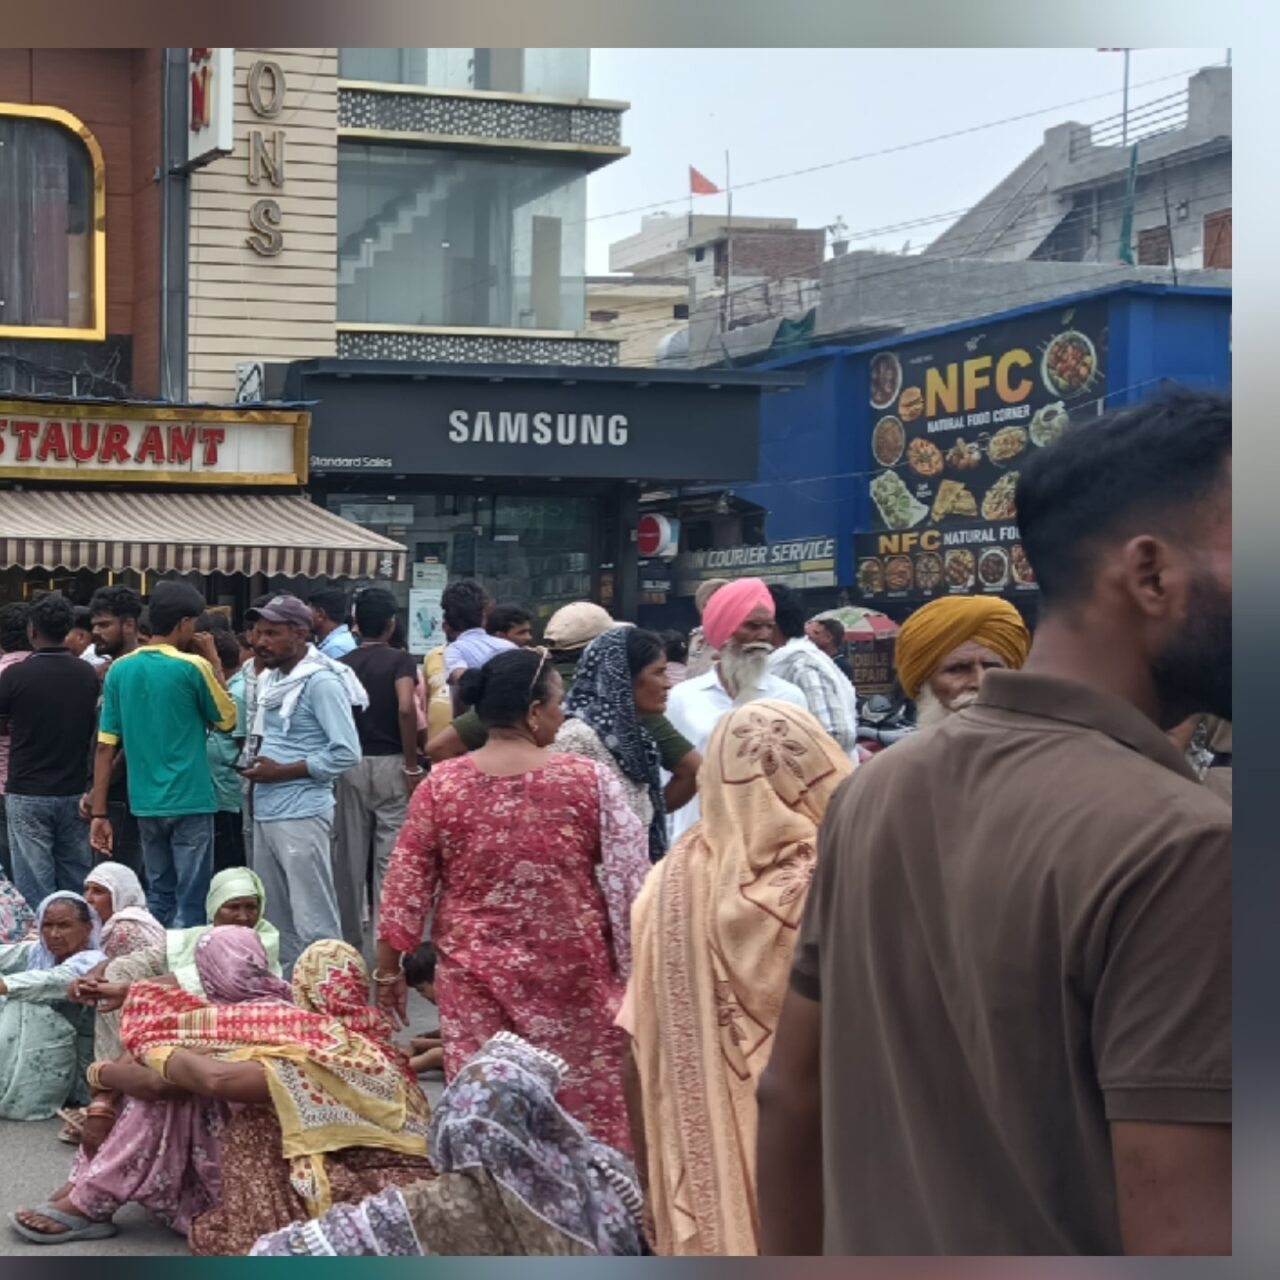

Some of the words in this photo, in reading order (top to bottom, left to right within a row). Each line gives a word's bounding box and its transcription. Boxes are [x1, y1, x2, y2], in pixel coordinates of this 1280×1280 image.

[925, 348, 1033, 417] NFC
[448, 409, 628, 446] SAMSUNG
[927, 414, 965, 433] NATURAL
[967, 411, 991, 427] FOOD
[993, 404, 1031, 422] CORNER
[362, 456, 393, 468] Sales
[707, 546, 768, 568] COURIER
[769, 539, 835, 564] SERVICE
[878, 530, 942, 555] NFC
[943, 528, 996, 545] NATURAL
